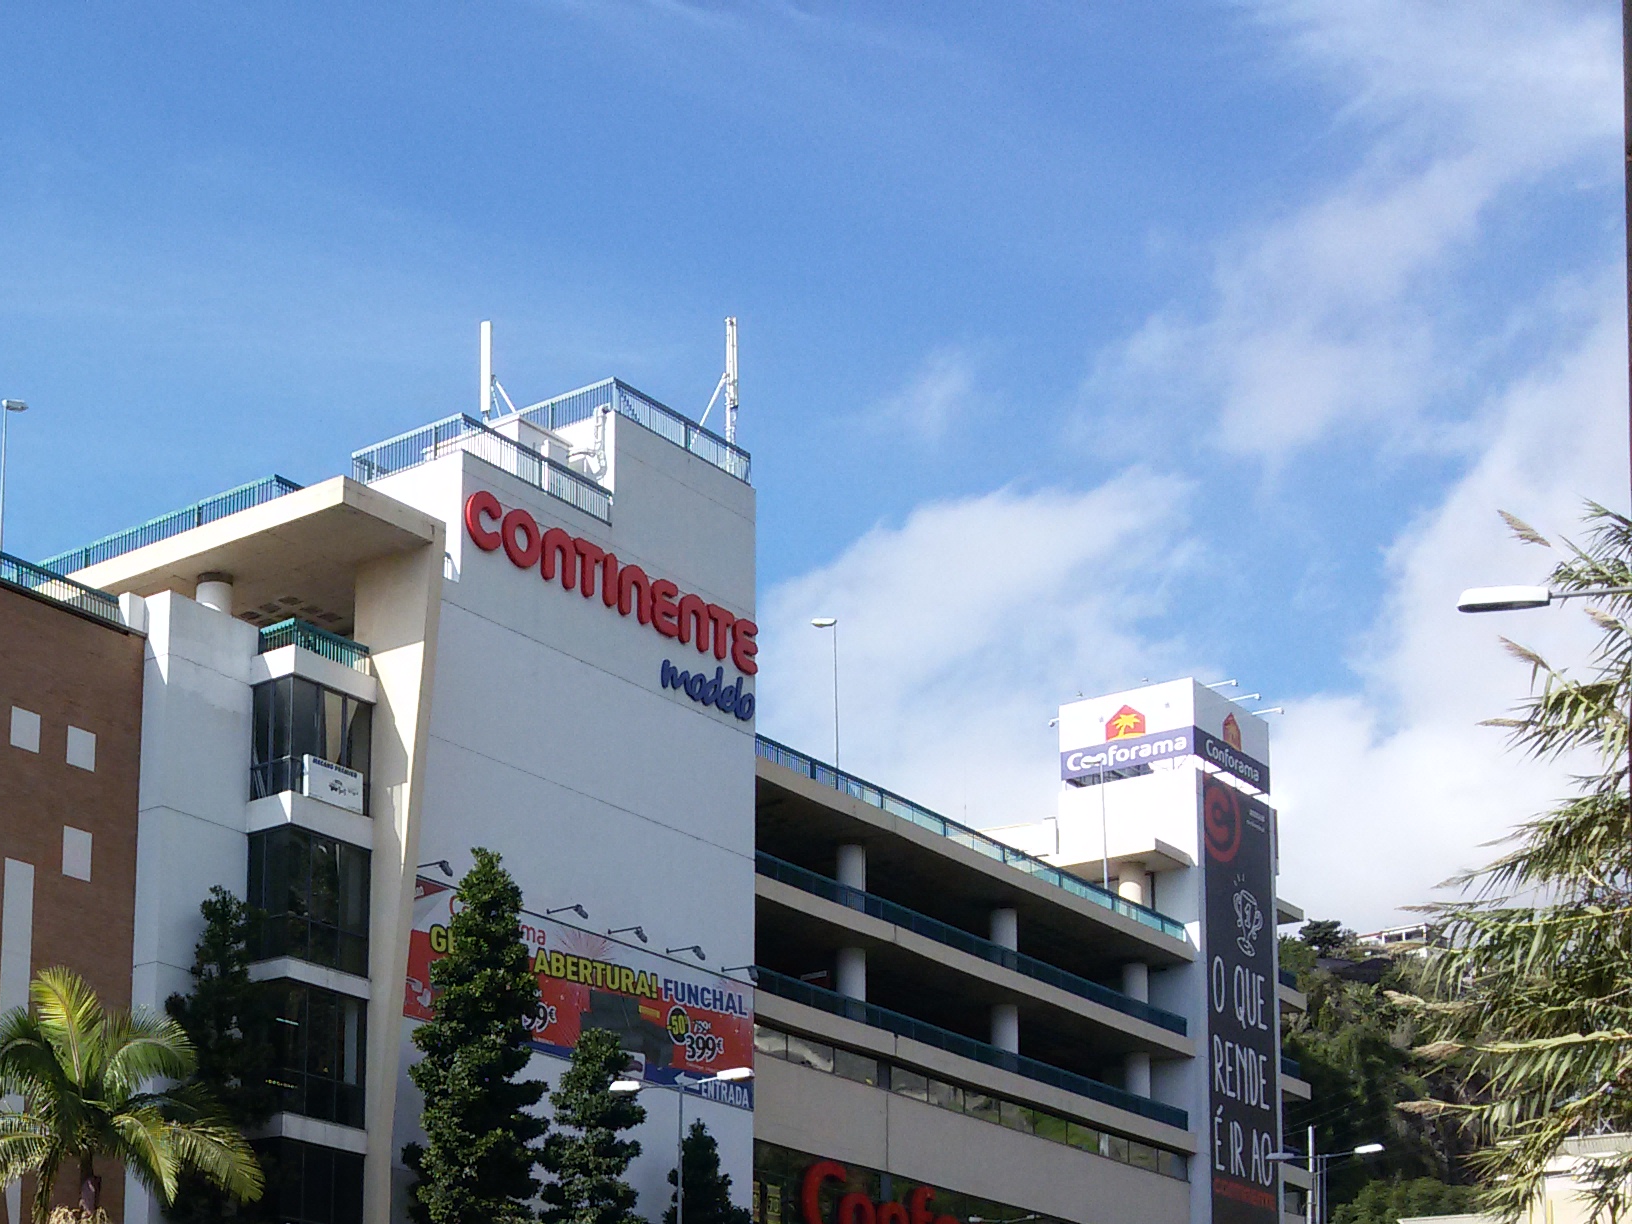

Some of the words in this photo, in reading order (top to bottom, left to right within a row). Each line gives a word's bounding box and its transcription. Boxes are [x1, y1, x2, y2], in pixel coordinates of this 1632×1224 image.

[466, 491, 758, 675] CONTINENTE
[661, 659, 755, 721] modelo
[1067, 734, 1187, 772] Conforama
[1205, 738, 1259, 783] Conforama
[533, 949, 659, 999] ABERTURA!
[663, 978, 748, 1018] FUNCHAL
[1213, 956, 1225, 1013] O
[1234, 965, 1267, 1030] QUE
[686, 1034, 724, 1061] 399€
[1213, 1034, 1270, 1110] RENDE
[701, 1077, 750, 1107] ENTRADA
[1214, 1104, 1225, 1171] É
[1230, 1120, 1245, 1178] IR
[1251, 1129, 1273, 1187] AO
